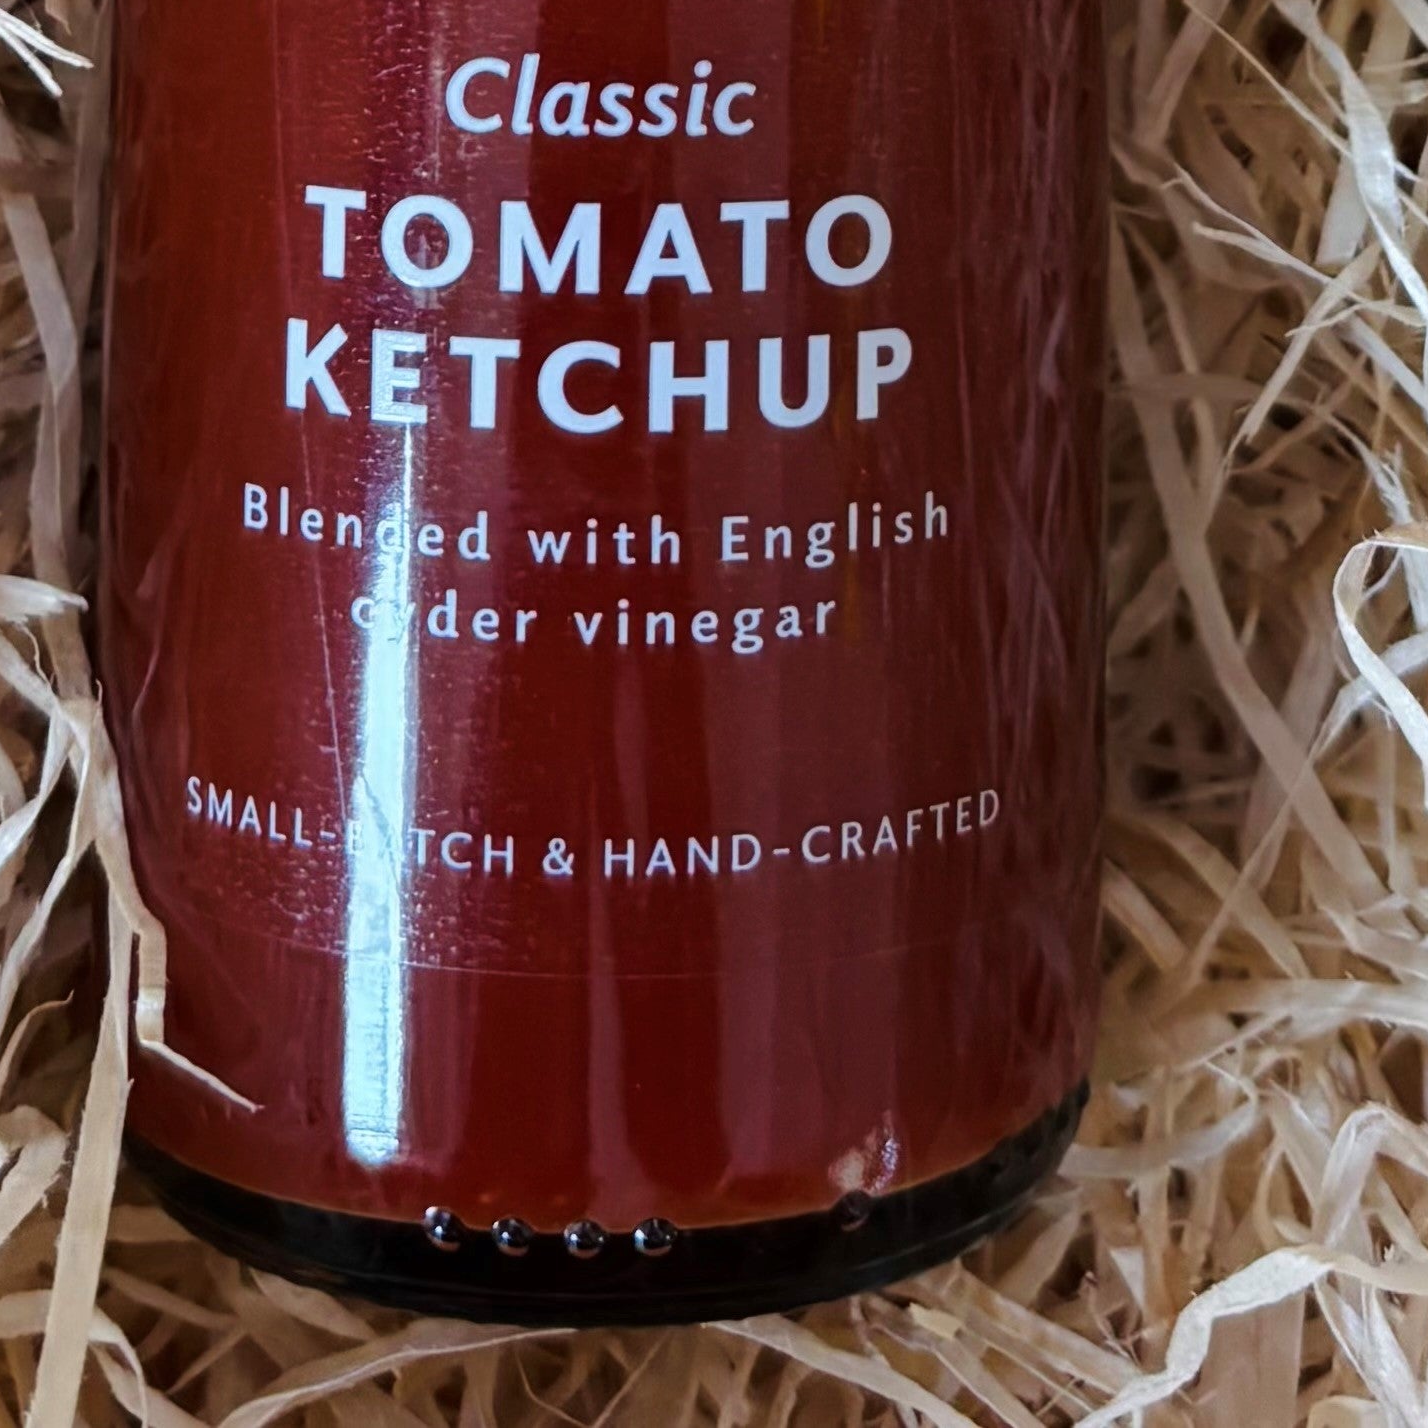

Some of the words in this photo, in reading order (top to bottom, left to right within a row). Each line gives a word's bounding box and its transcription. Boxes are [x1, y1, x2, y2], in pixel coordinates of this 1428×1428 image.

[445, 53, 756, 137] Classic
[305, 185, 892, 295] TOMATO
[285, 317, 912, 434] KETCHUP
[243, 482, 491, 561] Blended
[527, 515, 680, 565] with
[721, 491, 947, 569] English
[573, 598, 836, 655] vinegar
[542, 837, 574, 876] &
[604, 789, 999, 877] HAND-CRAFTED
